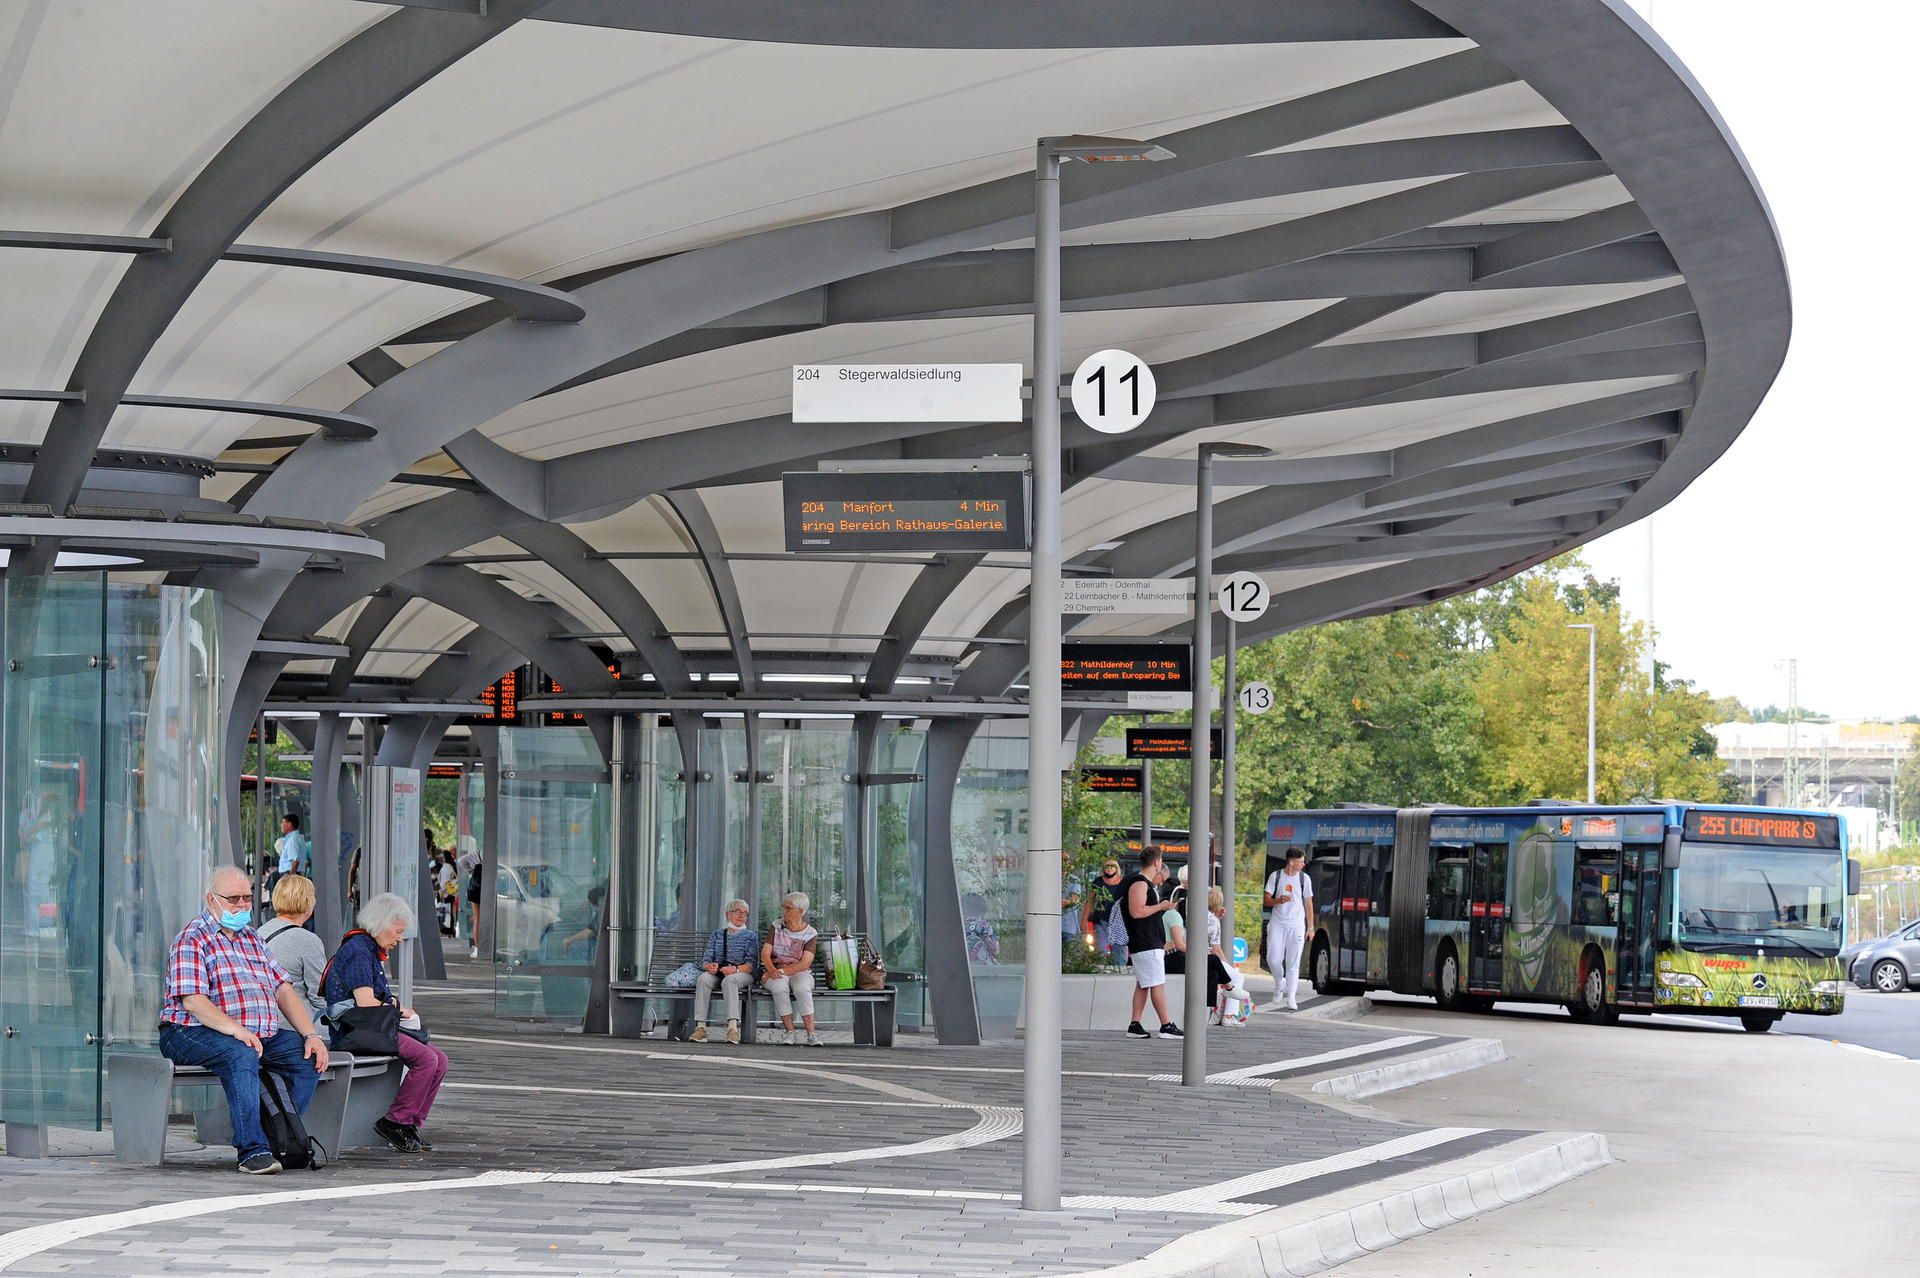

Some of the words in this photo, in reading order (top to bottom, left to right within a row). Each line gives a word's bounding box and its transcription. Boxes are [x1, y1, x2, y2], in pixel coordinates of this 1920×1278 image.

[797, 368, 820, 381] 204
[838, 368, 962, 383] Stegerwaldsiedlung
[1086, 364, 1139, 417] 11
[801, 501, 825, 514] 204
[843, 501, 896, 515] Manfort
[960, 501, 969, 512] 4
[975, 501, 1000, 512] Min
[840, 519, 890, 531] Bereich
[1075, 580, 1108, 589] Edelrath
[1115, 580, 1151, 589] Odenthal
[1075, 592, 1120, 600] Leimbacher
[1136, 592, 1186, 601] Mathildenhof
[1223, 580, 1261, 612] 12
[1075, 603, 1116, 614] Chempark
[1080, 660, 1134, 670] Mathildenhof
[1160, 660, 1176, 668] Min
[1086, 671, 1100, 680] auf
[1103, 671, 1119, 679] dem
[1121, 671, 1165, 681] Europaring
[1243, 687, 1269, 708] 13
[1699, 815, 1726, 836] 255
[1729, 817, 1800, 838] CHEMPARK
